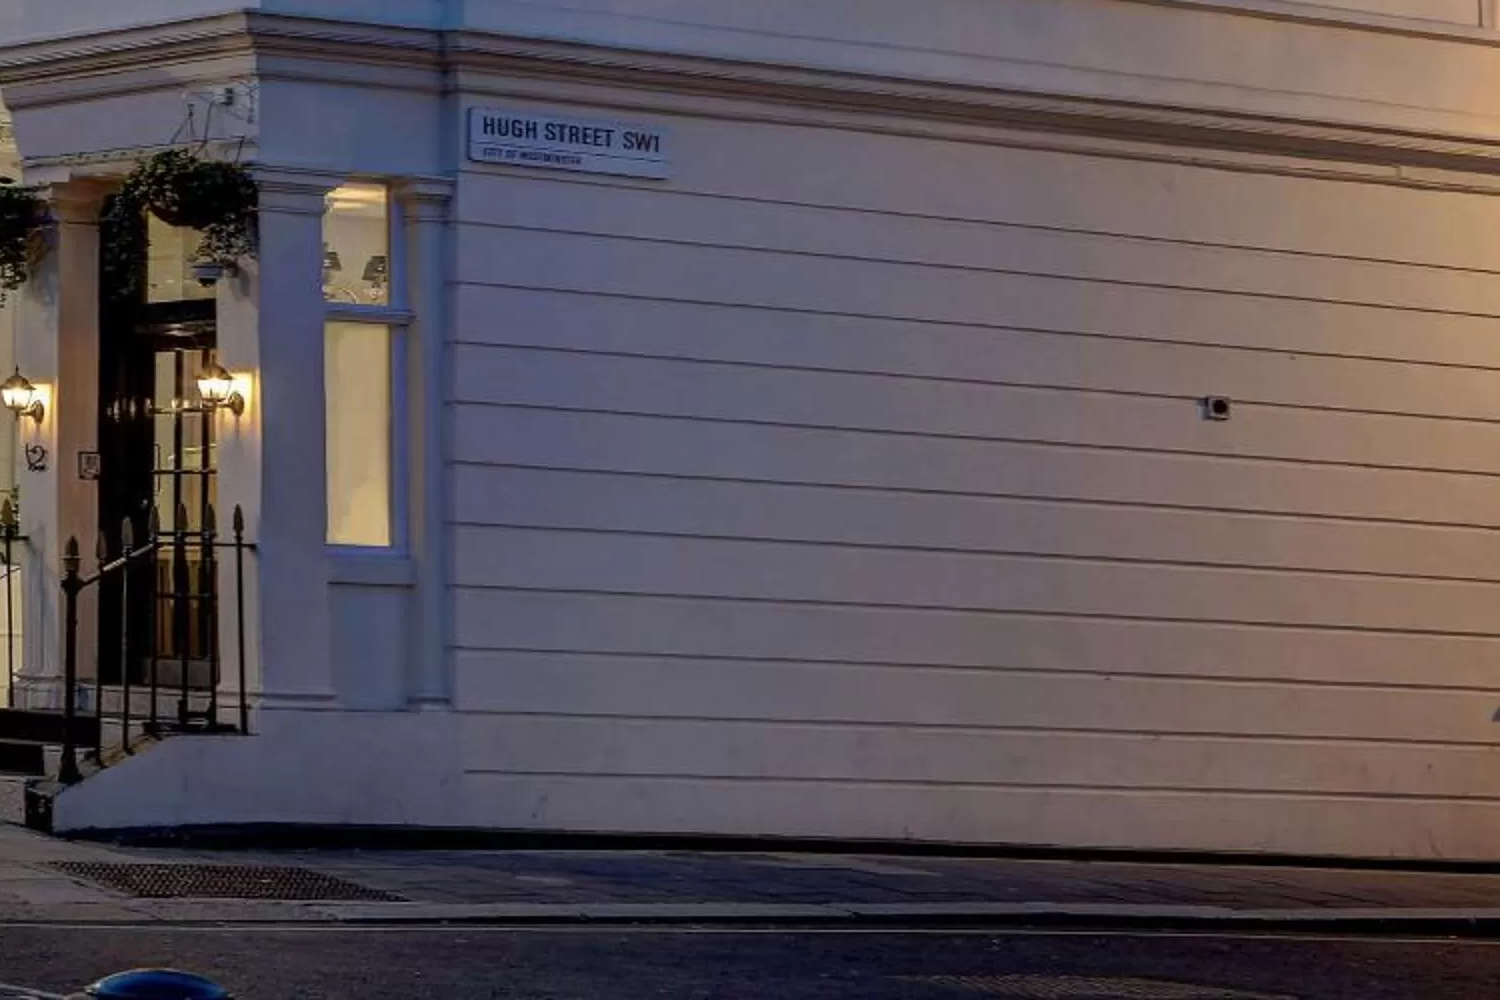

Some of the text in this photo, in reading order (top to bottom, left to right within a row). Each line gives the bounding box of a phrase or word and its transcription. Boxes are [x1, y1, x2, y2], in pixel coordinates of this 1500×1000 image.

[483, 116, 660, 153] HUGH STREET SW1
